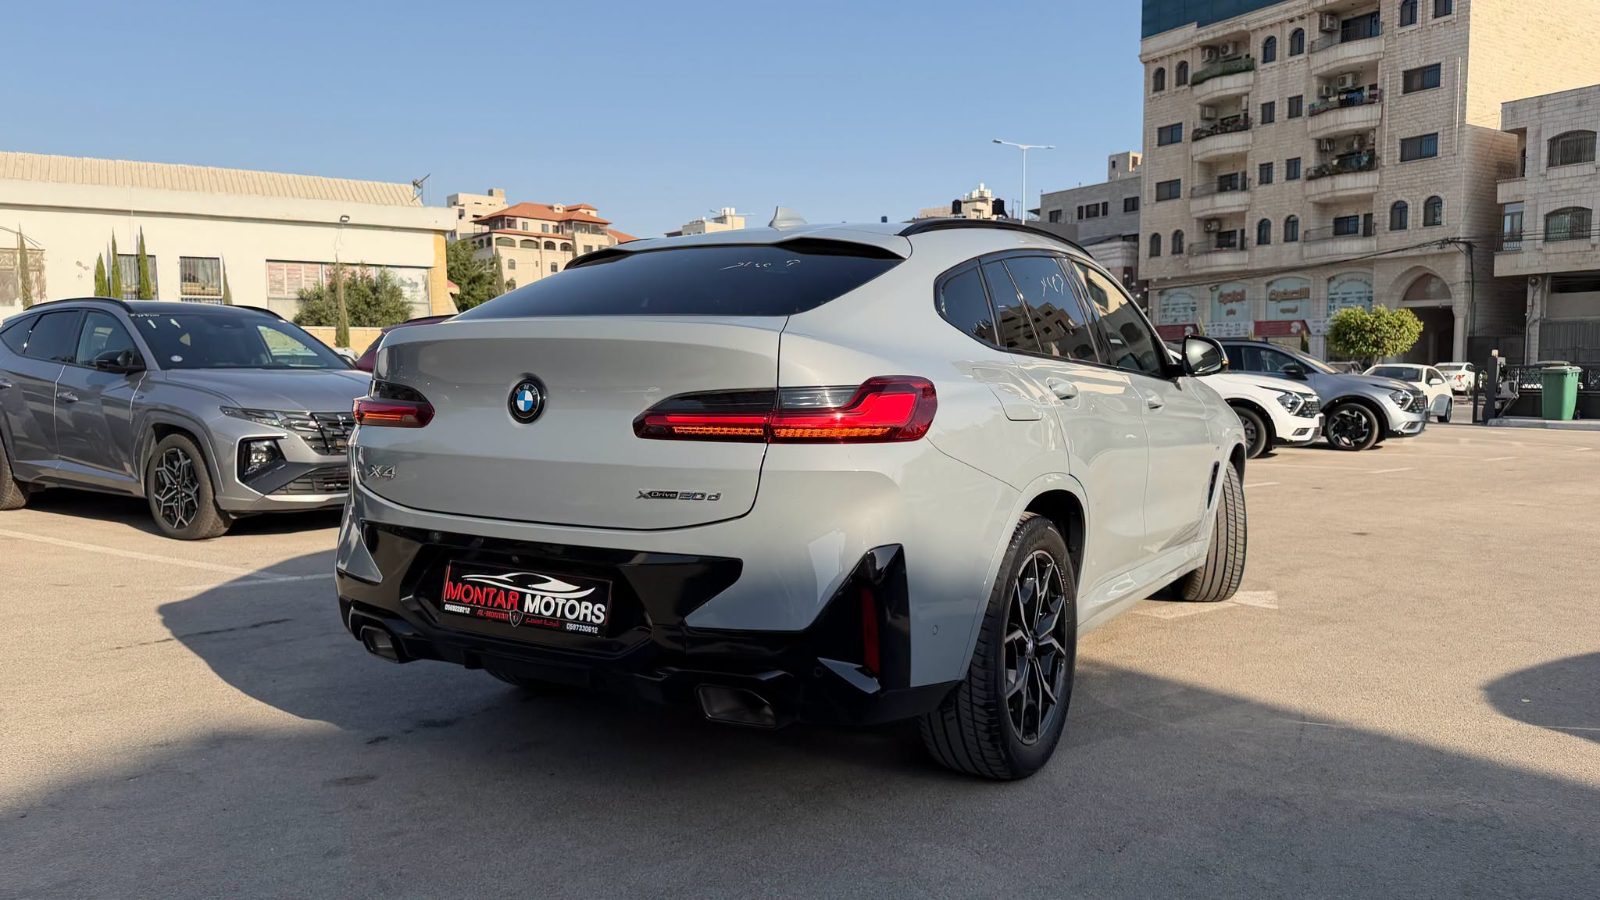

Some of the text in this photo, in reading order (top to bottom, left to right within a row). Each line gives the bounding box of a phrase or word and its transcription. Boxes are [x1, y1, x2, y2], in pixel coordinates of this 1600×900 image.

[369, 464, 396, 479] X4
[445, 581, 606, 625] MONTAR MOTORS
